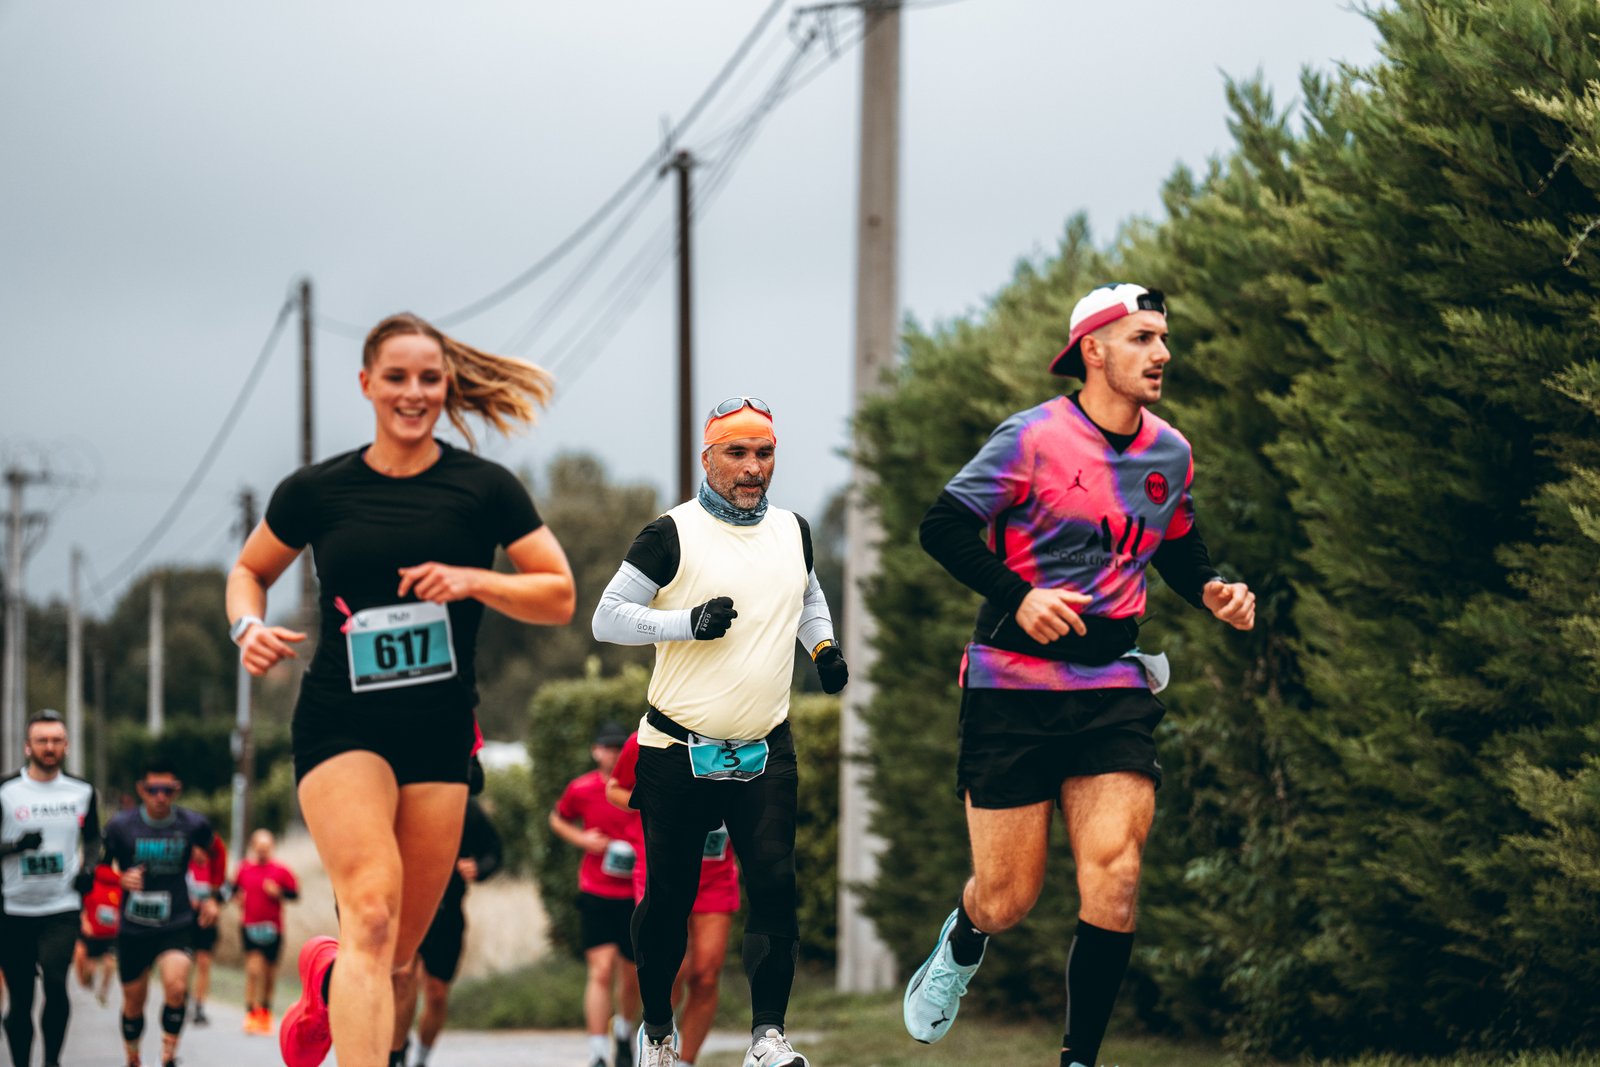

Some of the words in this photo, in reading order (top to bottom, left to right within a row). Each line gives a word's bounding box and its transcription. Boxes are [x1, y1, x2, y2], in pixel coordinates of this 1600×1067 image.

[637, 623, 657, 633] GORE
[700, 613, 712, 632] GORE
[374, 628, 430, 670] 617
[721, 748, 741, 768] 3
